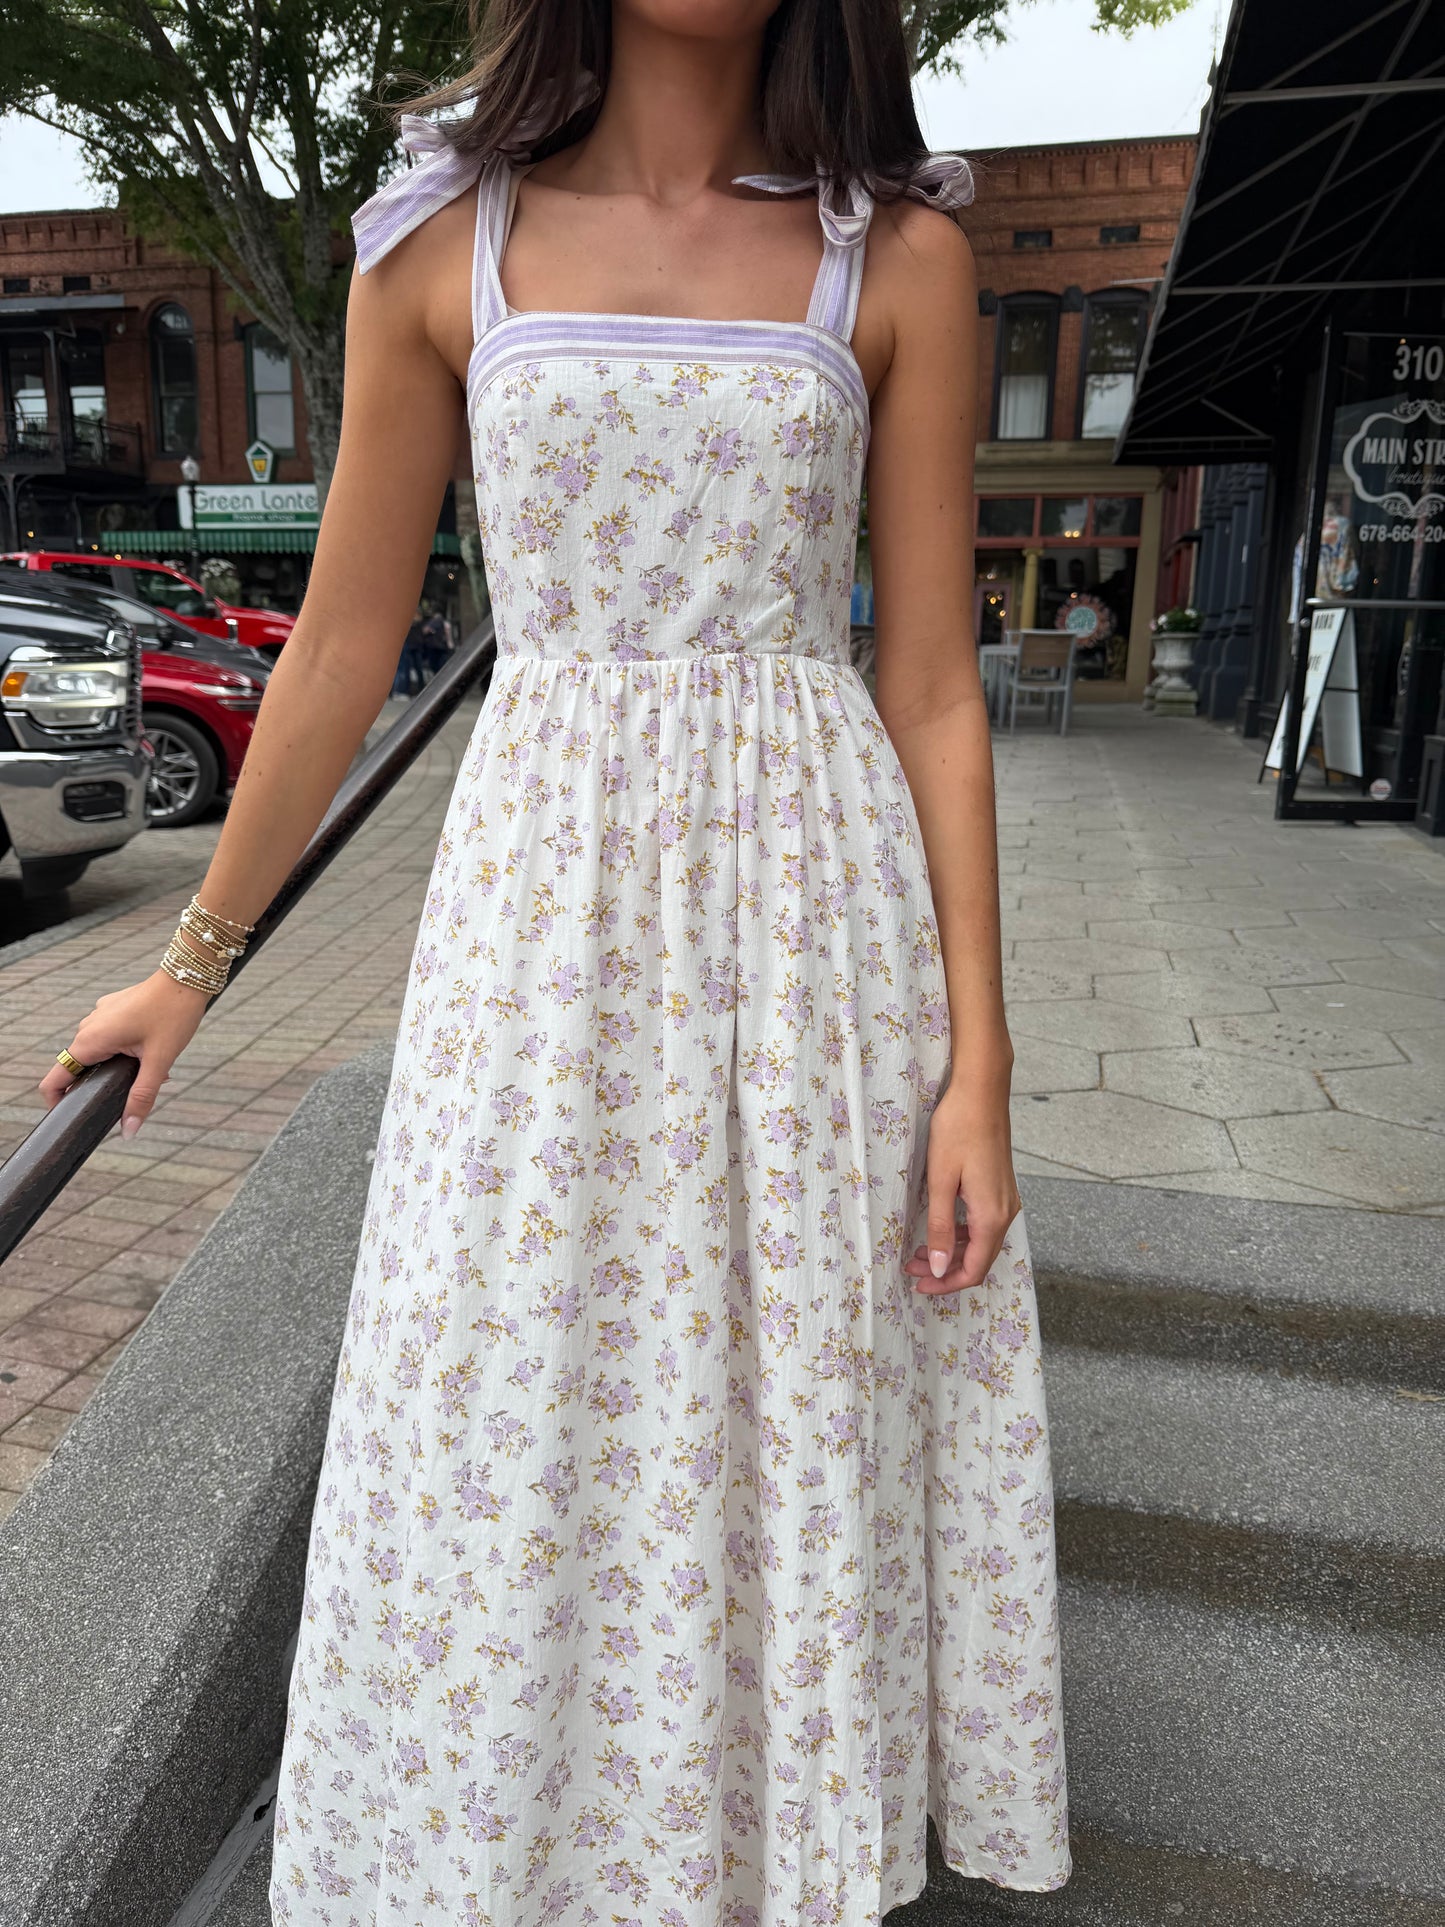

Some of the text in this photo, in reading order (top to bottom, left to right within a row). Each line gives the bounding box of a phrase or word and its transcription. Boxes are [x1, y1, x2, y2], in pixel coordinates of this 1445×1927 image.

[1393, 345, 1445, 381] 310
[1362, 438, 1408, 464] MAIN
[195, 489, 254, 510] Green
